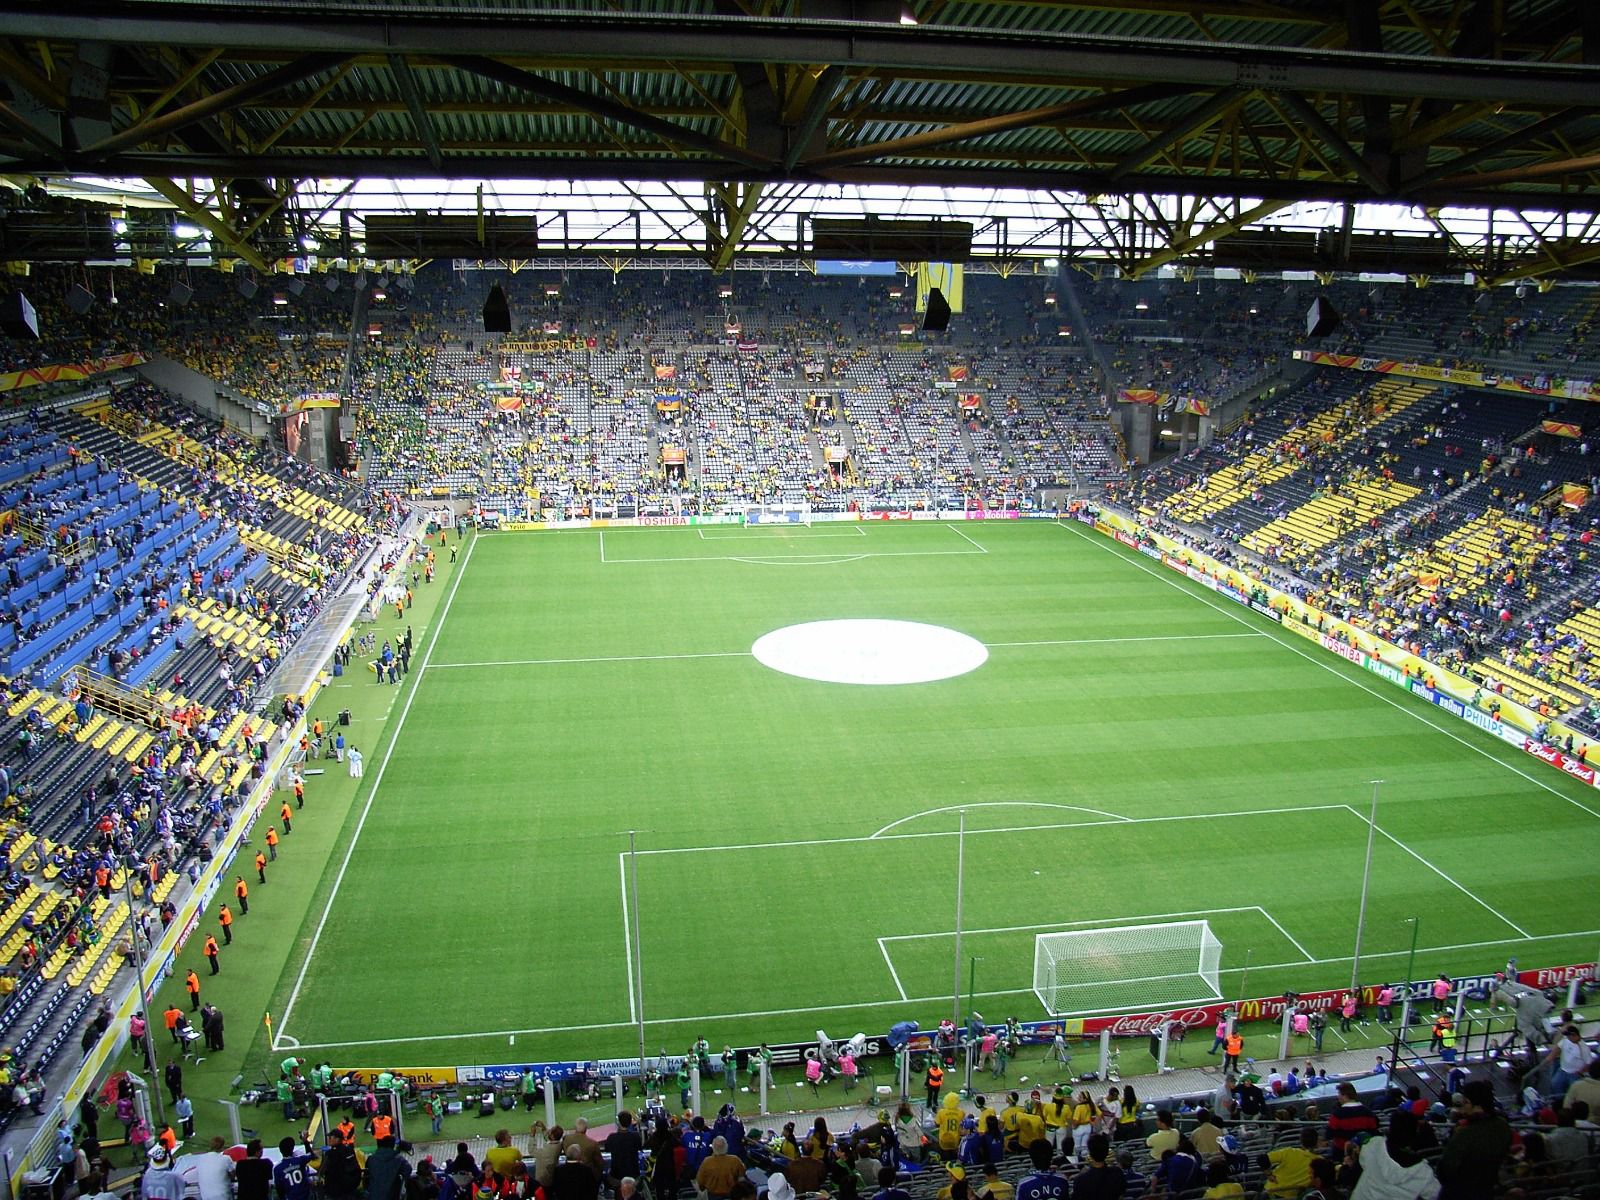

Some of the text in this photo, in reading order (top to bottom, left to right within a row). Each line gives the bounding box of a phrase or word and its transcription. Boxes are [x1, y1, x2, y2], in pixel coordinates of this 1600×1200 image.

[549, 341, 574, 350] SPRT
[639, 517, 687, 526] TOSHIBA
[1323, 636, 1361, 663] TOSHIBA
[1466, 709, 1503, 736] PHILIPS
[1527, 739, 1593, 780] Bud Bud
[1537, 970, 1563, 986] Fly
[946, 1119, 957, 1132] 18
[285, 1169, 303, 1186] 10
